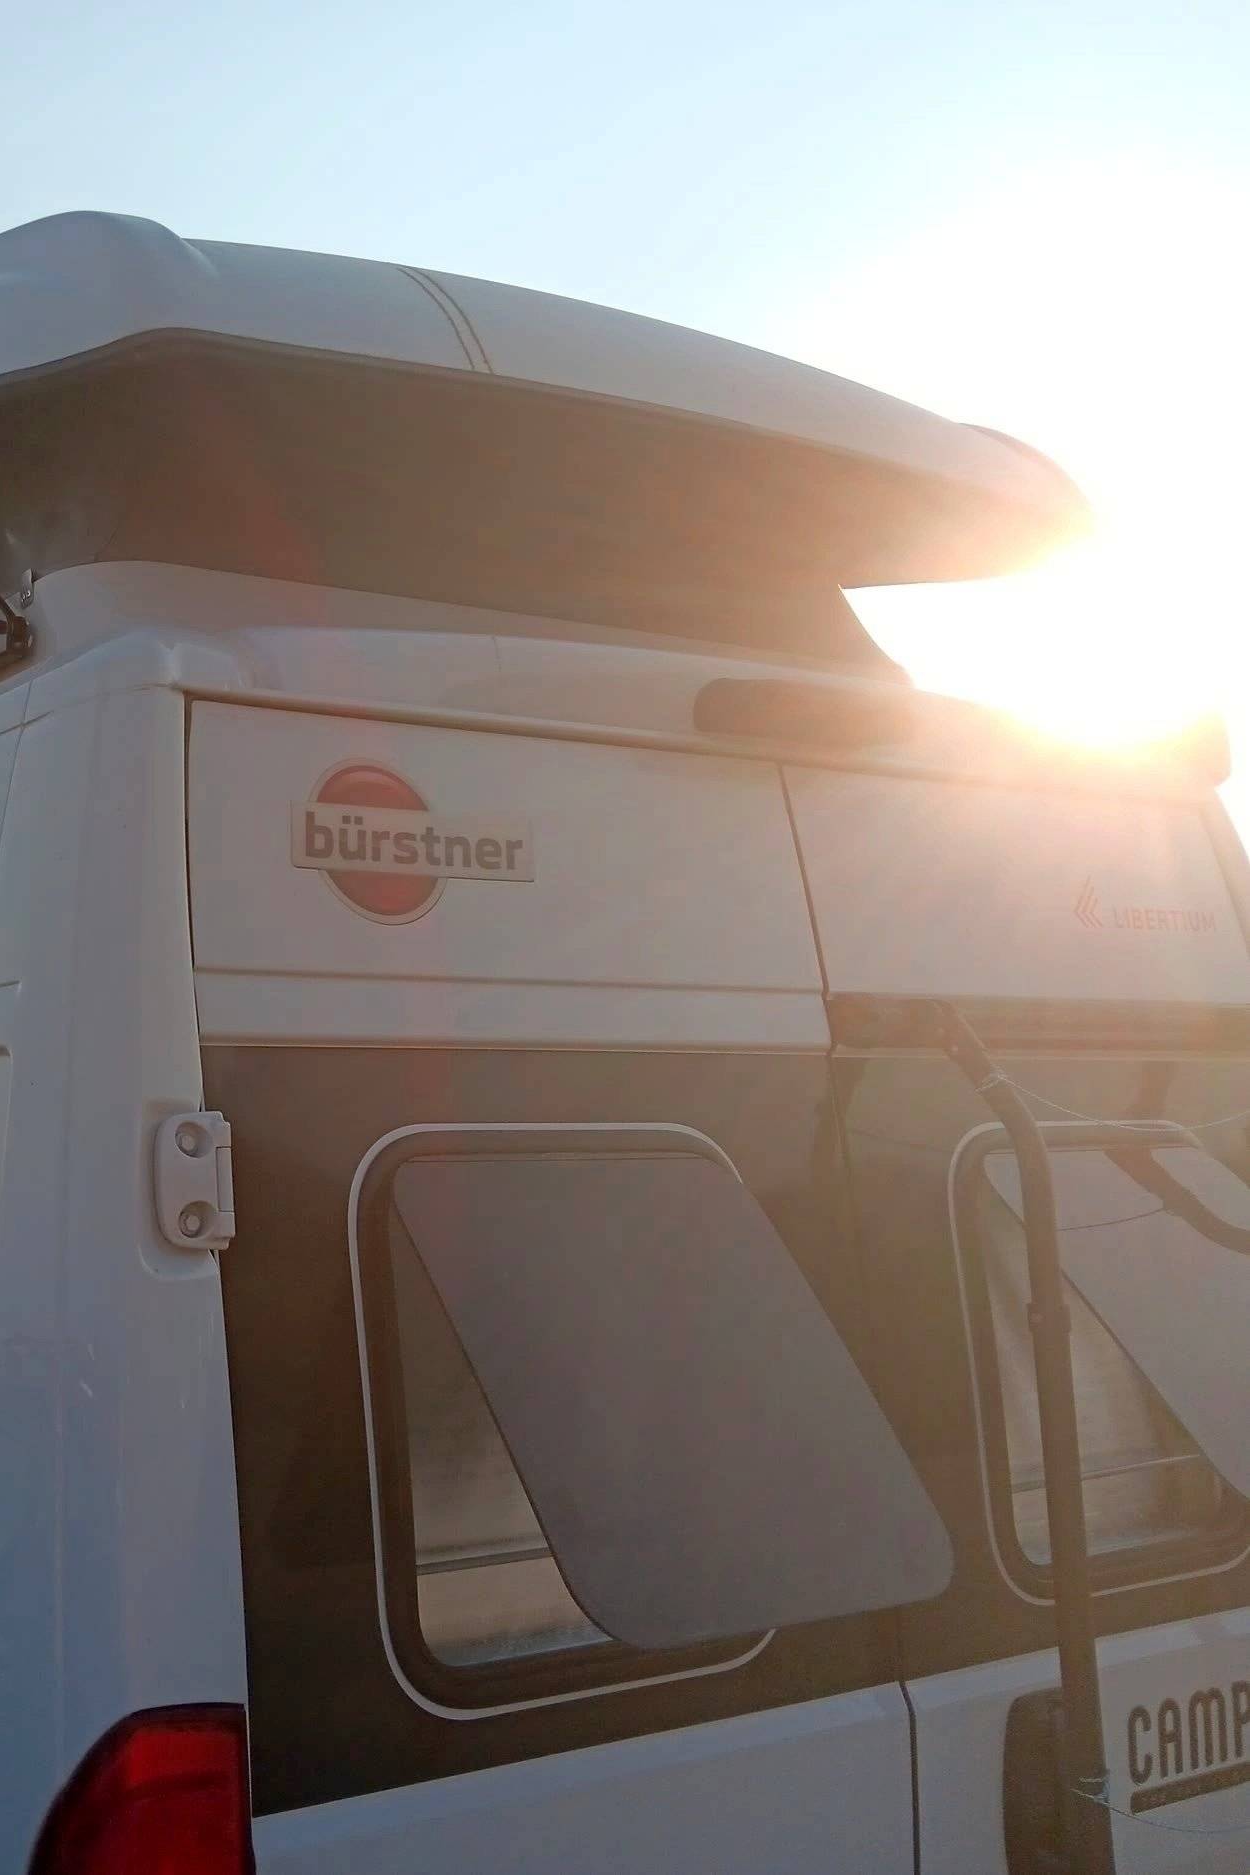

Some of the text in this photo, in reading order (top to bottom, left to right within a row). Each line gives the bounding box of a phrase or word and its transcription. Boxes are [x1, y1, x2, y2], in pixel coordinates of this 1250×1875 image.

[305, 811, 523, 870] bürstner
[1112, 903, 1217, 932] LIBERTIUM
[1128, 1680, 1250, 1785] CAMP
